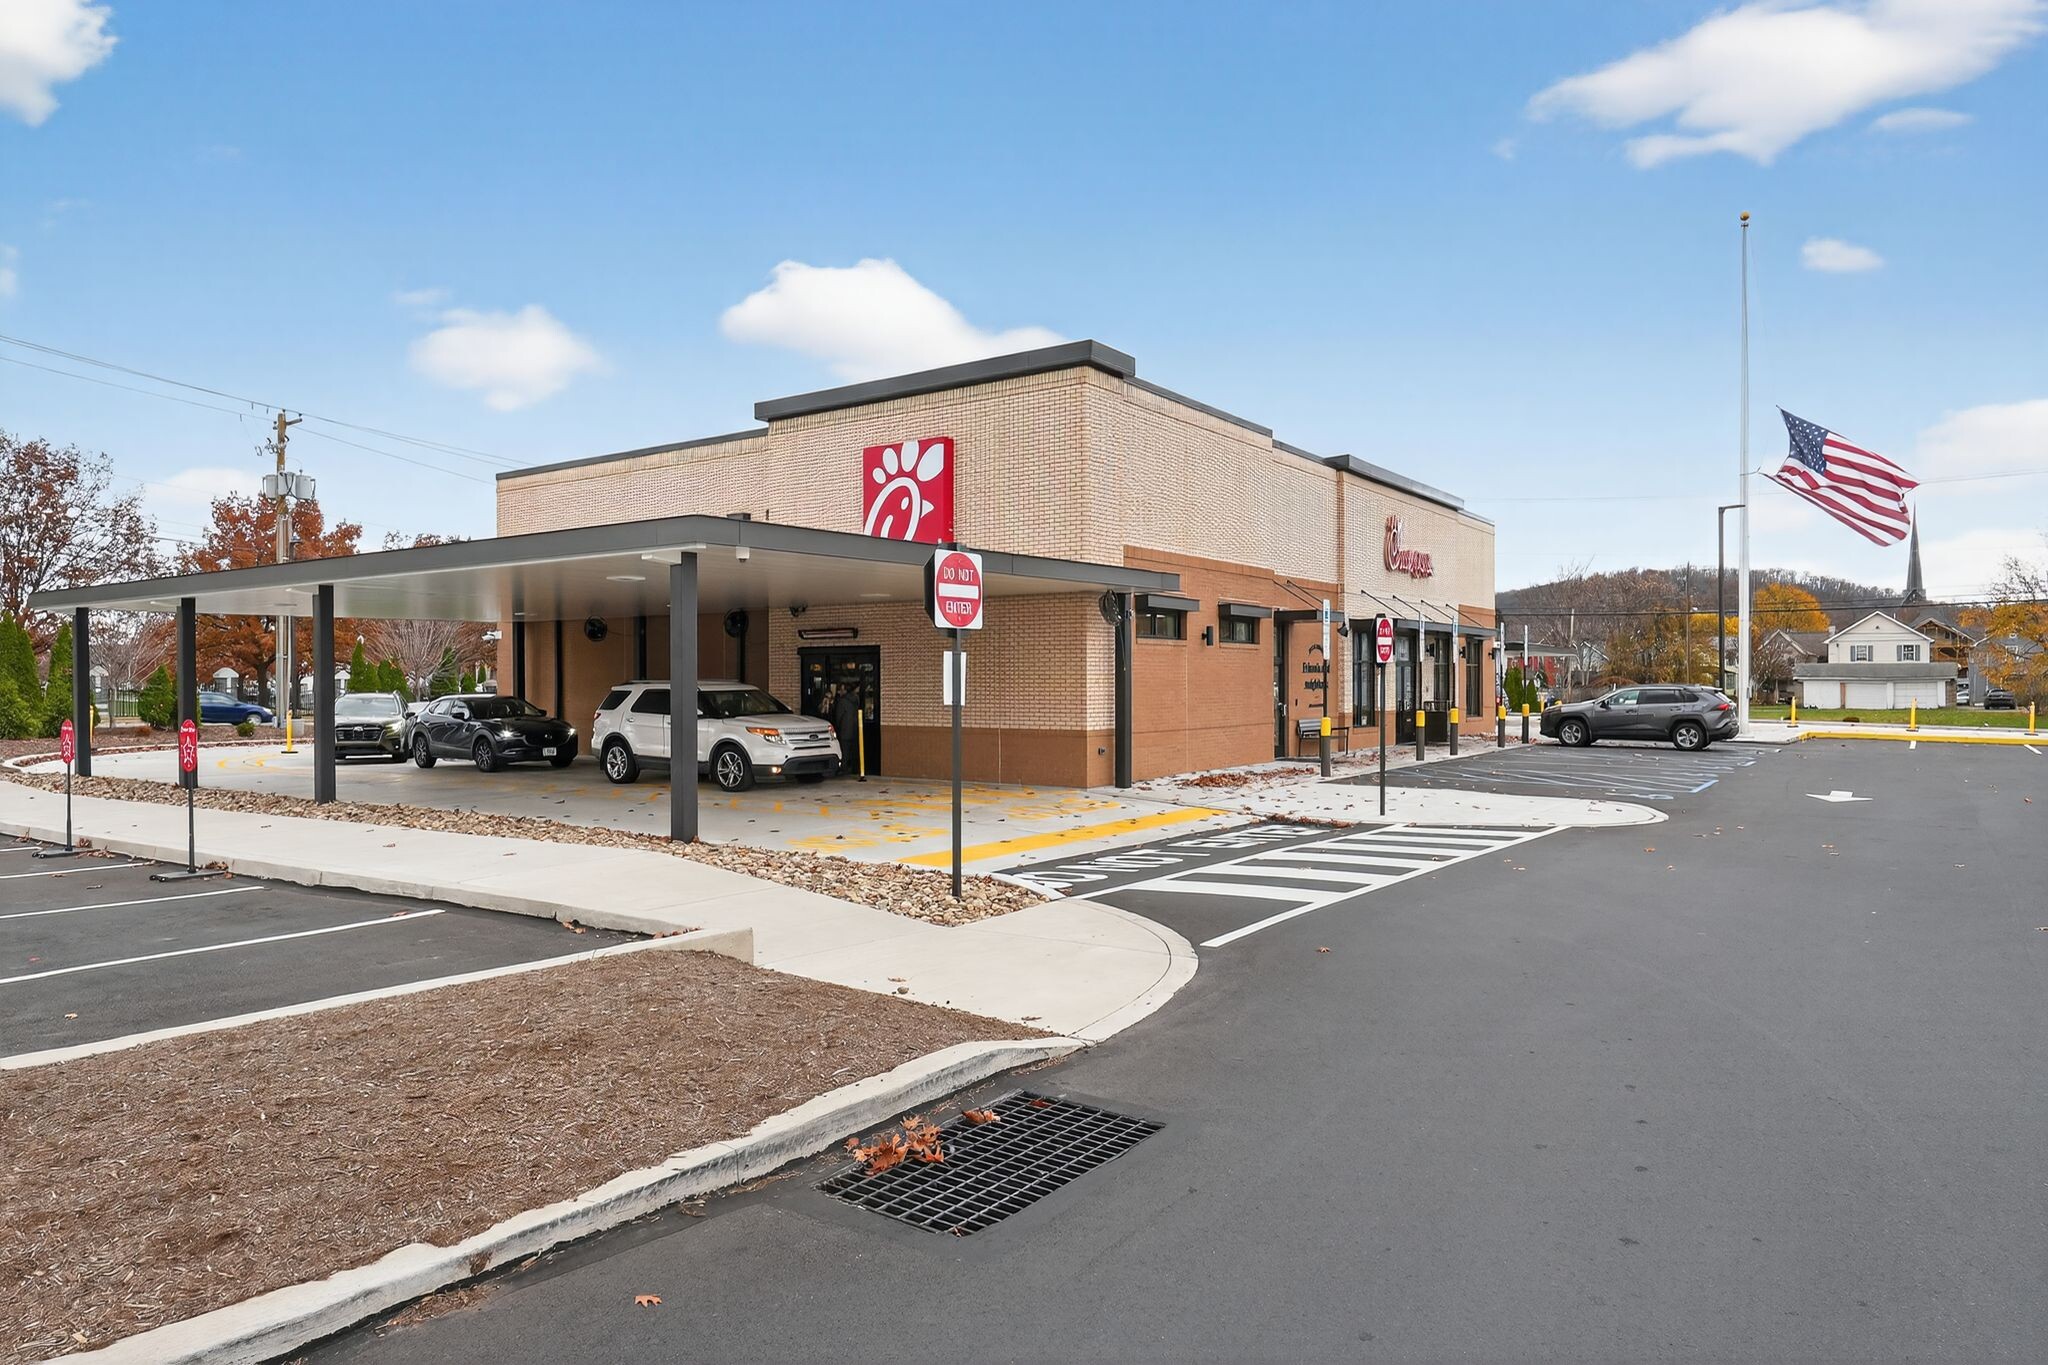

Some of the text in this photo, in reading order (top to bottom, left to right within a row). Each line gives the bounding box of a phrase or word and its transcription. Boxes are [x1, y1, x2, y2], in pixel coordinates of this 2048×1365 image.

[943, 567, 974, 582] DO NOT
[946, 601, 972, 615] ENTER
[1056, 849, 1211, 873] NOT
